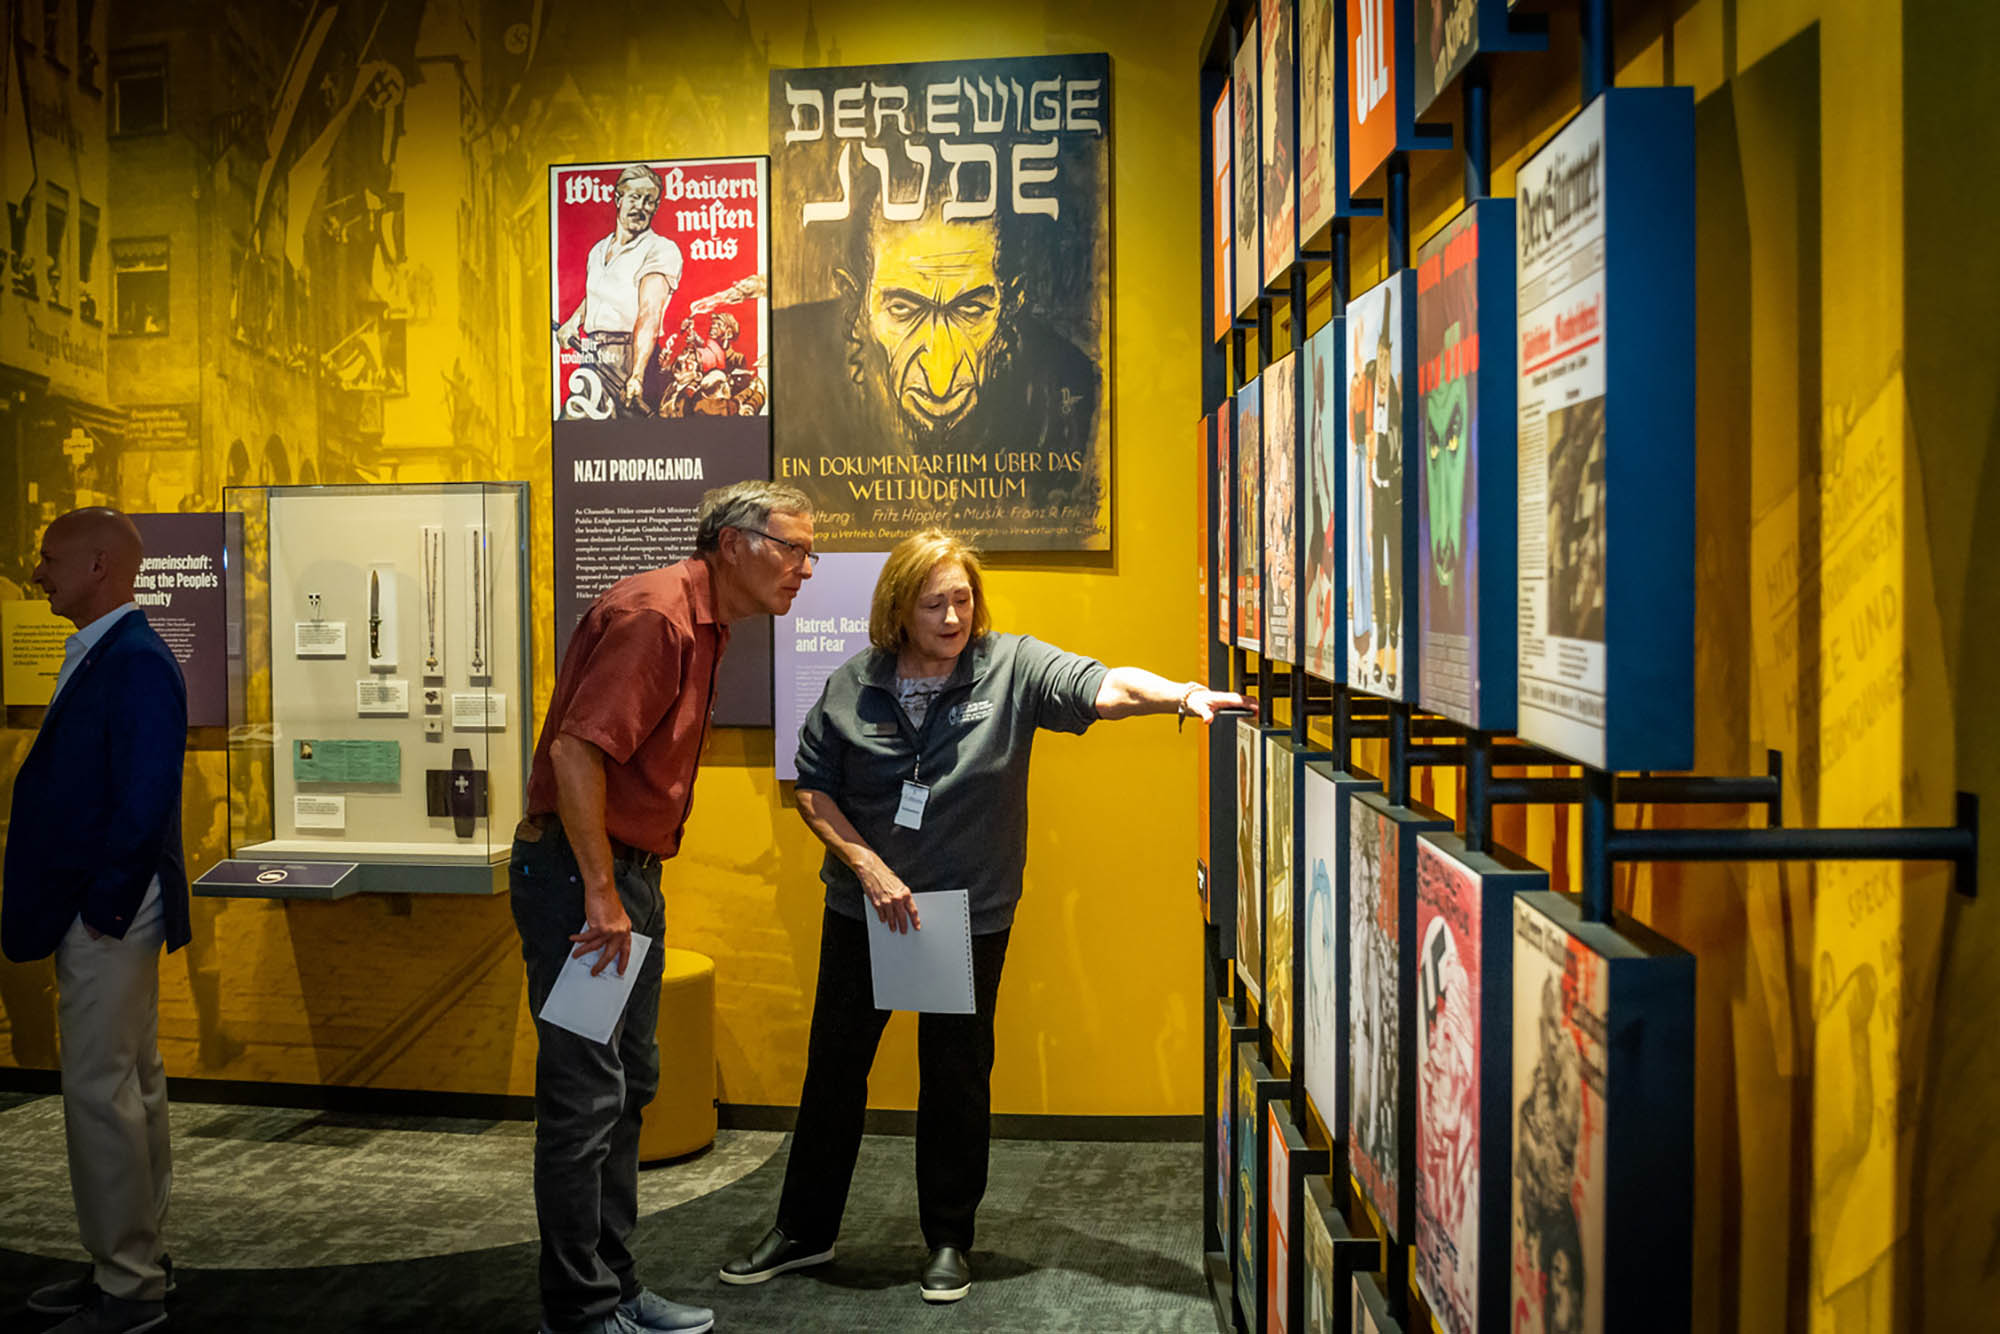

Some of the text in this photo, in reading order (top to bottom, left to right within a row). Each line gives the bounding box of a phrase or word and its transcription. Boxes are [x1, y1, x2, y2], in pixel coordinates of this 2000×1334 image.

[785, 73, 1103, 144] DER EWIGE
[565, 175, 615, 204] Wir
[802, 137, 1061, 228] JUDE
[574, 457, 704, 482] NAZI PROPAGANDA
[782, 450, 1083, 478] EIN DOKUMENTARFILM ÜBER DAS
[848, 476, 1027, 502] WELTJUDENTUM
[649, 516, 682, 525] Propaganda
[872, 507, 900, 522] Fritz
[140, 554, 213, 572] gemeinschaft:
[576, 563, 609, 572] Propaganda
[134, 572, 219, 590] ting the People's
[134, 590, 172, 607] munity
[795, 616, 870, 634] Hatred, Racis
[795, 636, 846, 652] and Fear
